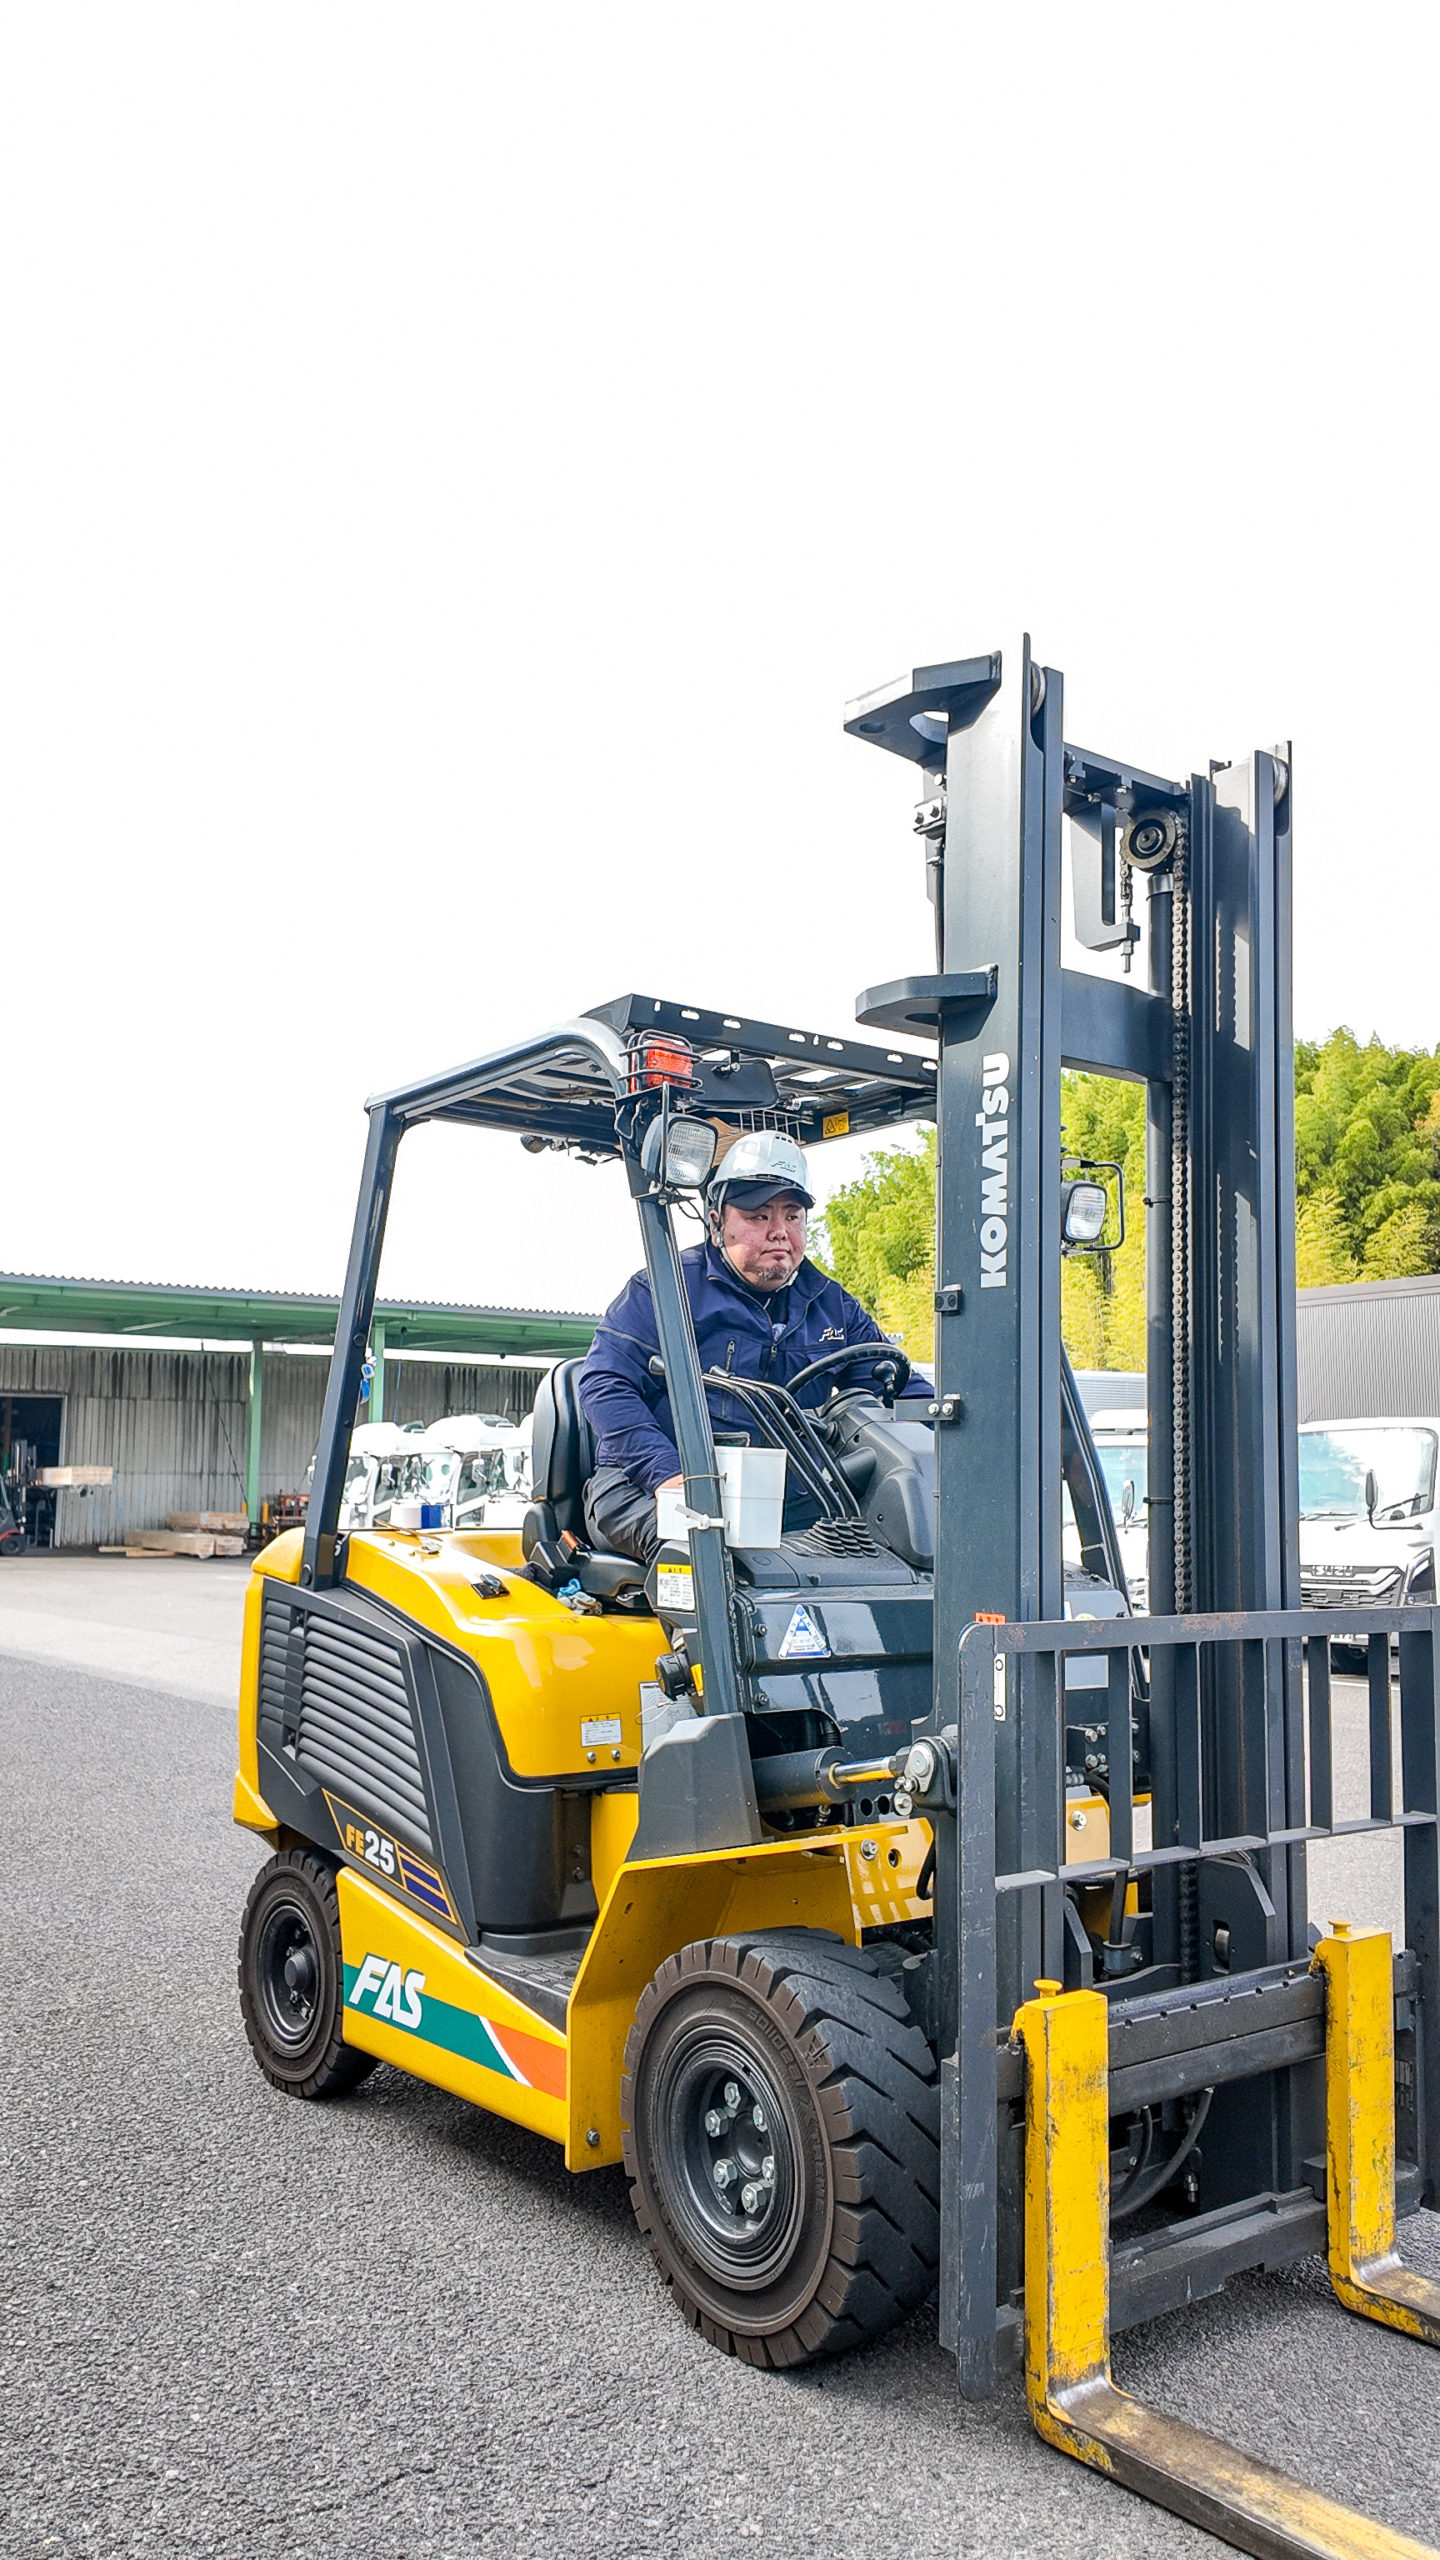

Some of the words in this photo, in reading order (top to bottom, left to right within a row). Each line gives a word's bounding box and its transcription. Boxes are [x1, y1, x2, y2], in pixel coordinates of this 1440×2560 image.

[975, 1052, 1010, 1289] KOMATSU
[345, 1823, 395, 1875] FE25
[348, 1953, 426, 2030] FAS
